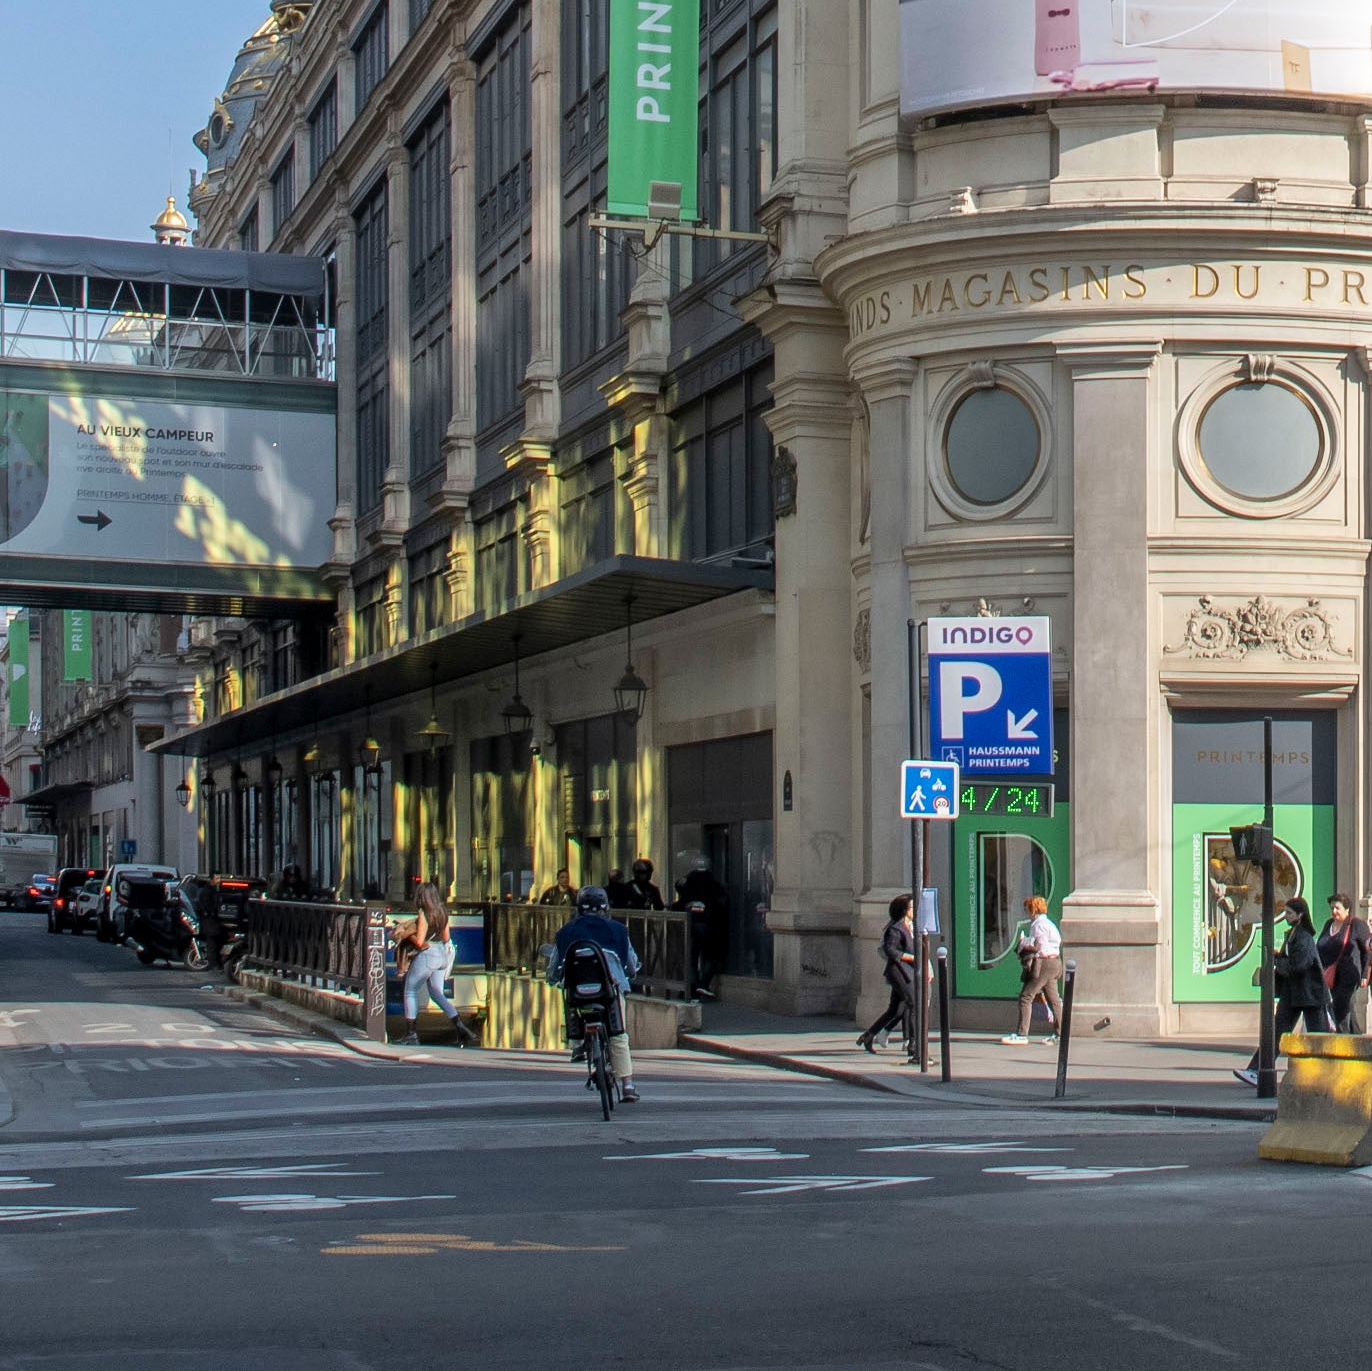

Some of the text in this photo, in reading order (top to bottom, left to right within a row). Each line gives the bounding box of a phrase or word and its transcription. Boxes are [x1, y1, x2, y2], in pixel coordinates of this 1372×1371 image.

[910, 264, 1147, 318] MAGASINS
[1190, 264, 1262, 299] DU
[77, 424, 214, 442] AU VIEUX CAMPEUR
[943, 626, 1034, 646] INDIGO
[940, 661, 1003, 740] P
[968, 746, 1040, 757] HAUSSMANN
[968, 758, 1031, 768] PRINTEMPS
[1007, 787, 1040, 814] 24
[1192, 833, 1201, 974] TOUT COMMENCE AU PRINTEMPS
